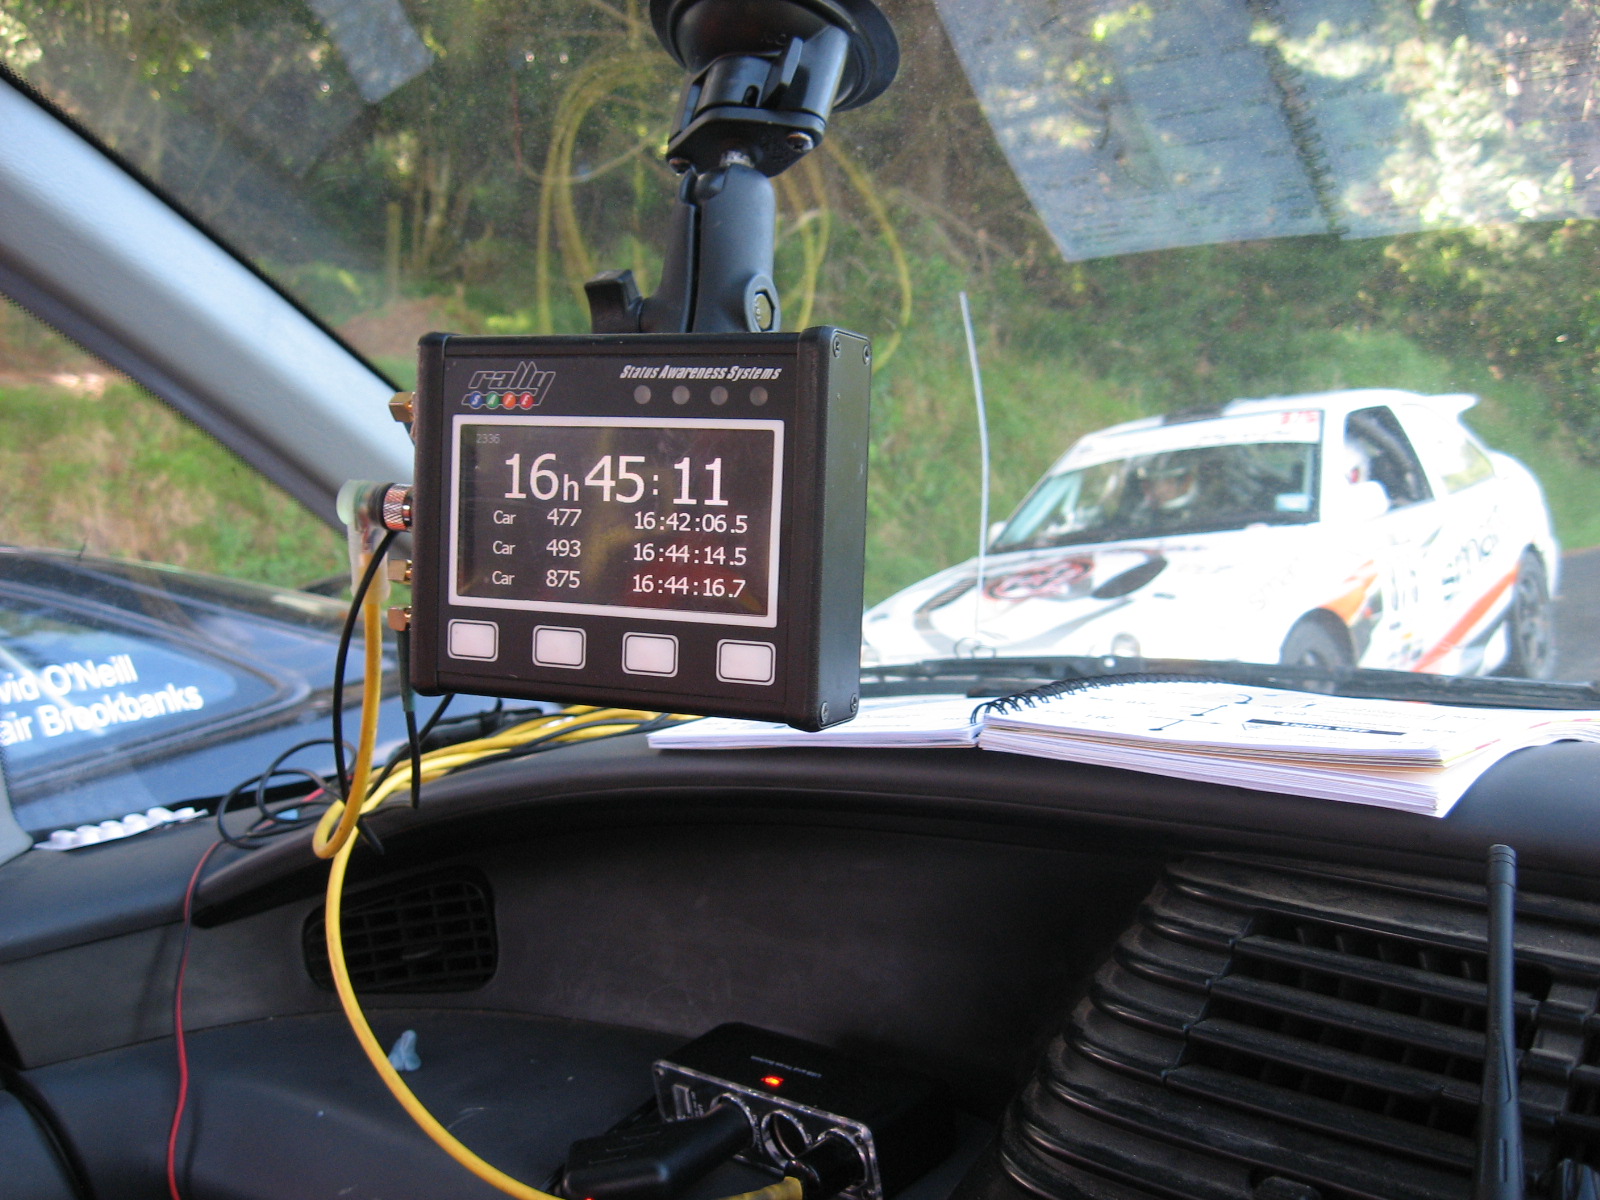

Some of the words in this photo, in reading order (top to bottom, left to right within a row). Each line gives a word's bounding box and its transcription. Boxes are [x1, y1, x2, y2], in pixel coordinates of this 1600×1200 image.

[467, 360, 556, 406] rally
[619, 364, 661, 379] Status
[657, 365, 728, 380] Awareness
[725, 365, 783, 382] Systems
[469, 391, 535, 409] SAFE
[493, 509, 517, 525] Car
[546, 507, 583, 527] 477
[634, 510, 748, 534] 16:42:06.5
[492, 540, 516, 556] Car
[545, 538, 582, 558] 493
[633, 542, 747, 567] 16:44:14.5
[491, 570, 516, 586] Car
[545, 569, 581, 589] 875
[632, 573, 746, 598] 16:44:16.7
[42, 654, 138, 696] O'Neill
[38, 683, 204, 737] Brookbanks
